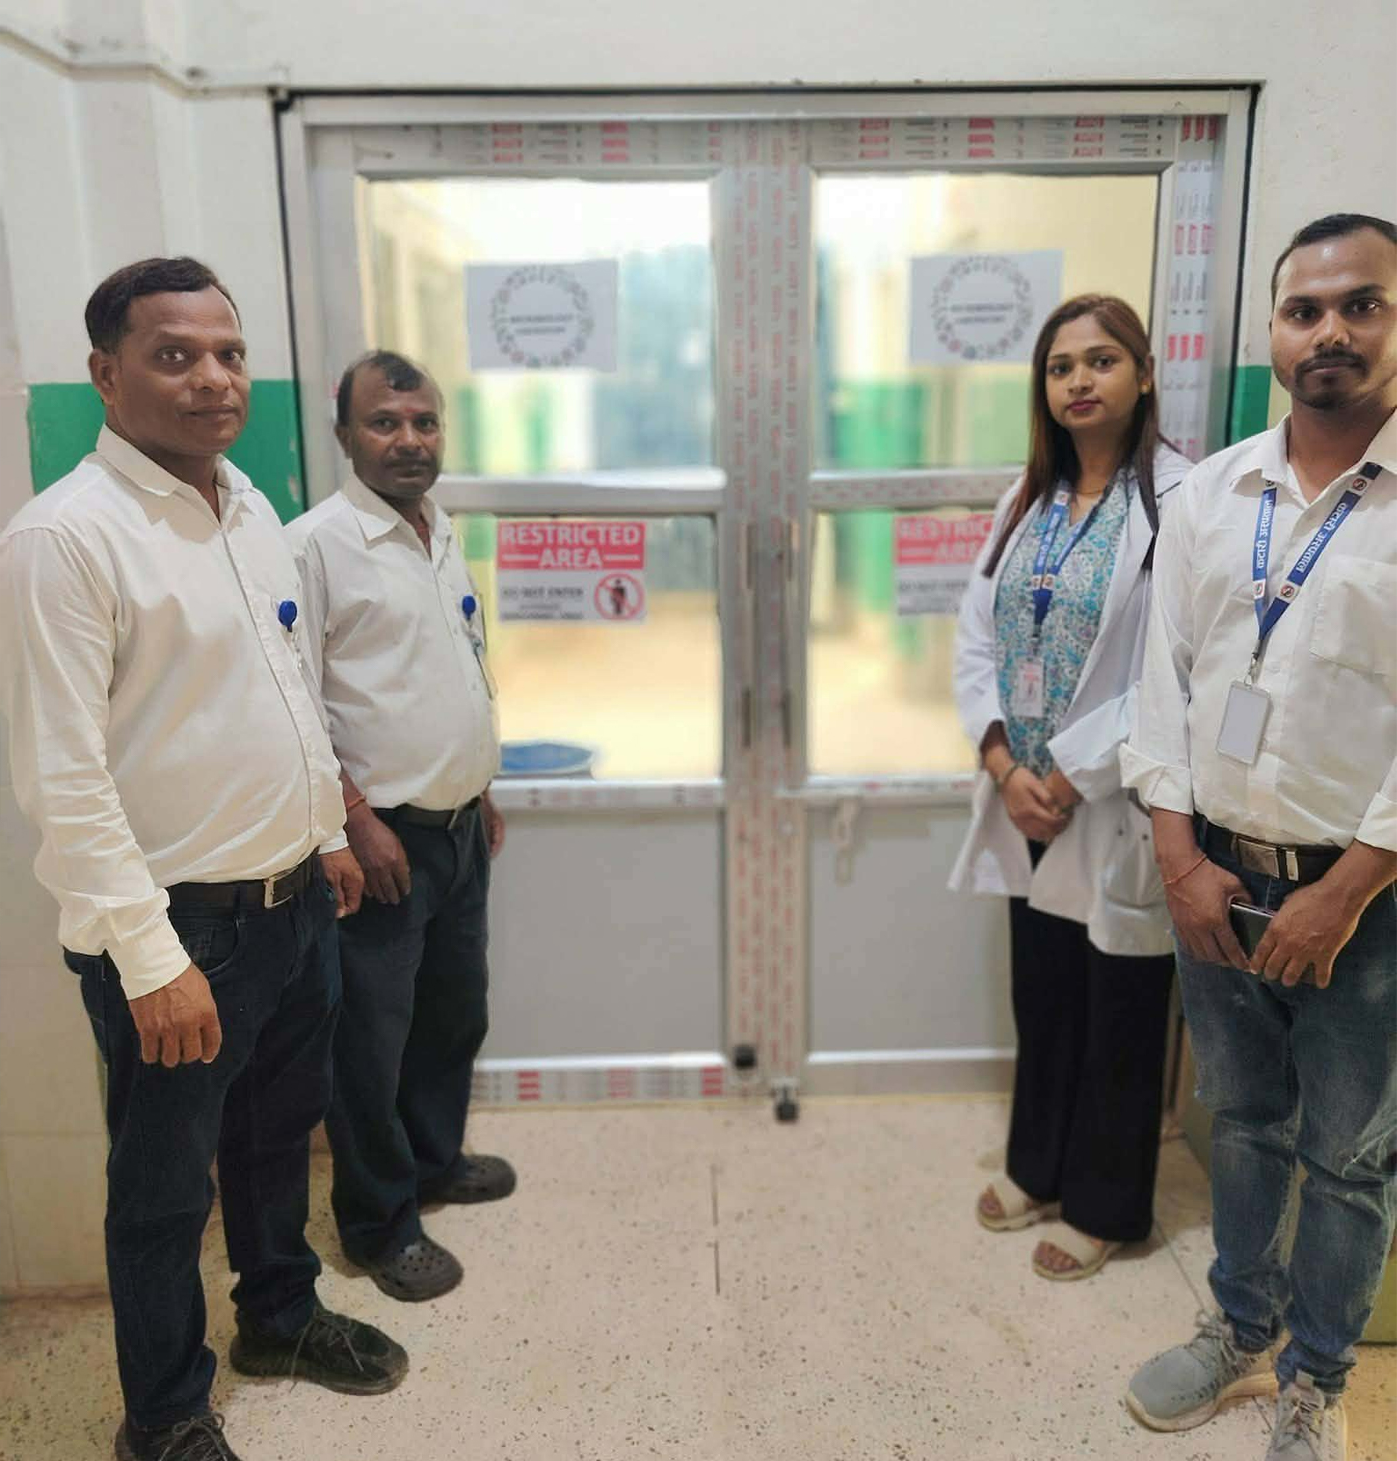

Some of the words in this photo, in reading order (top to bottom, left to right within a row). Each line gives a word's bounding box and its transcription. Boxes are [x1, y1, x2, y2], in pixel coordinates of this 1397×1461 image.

[900, 520, 991, 538] RESTRIC
[1259, 499, 1273, 538] अस्पताल
[502, 525, 640, 546] RESTRICTED
[540, 548, 602, 567] AREA
[1256, 539, 1267, 569] कटारी
